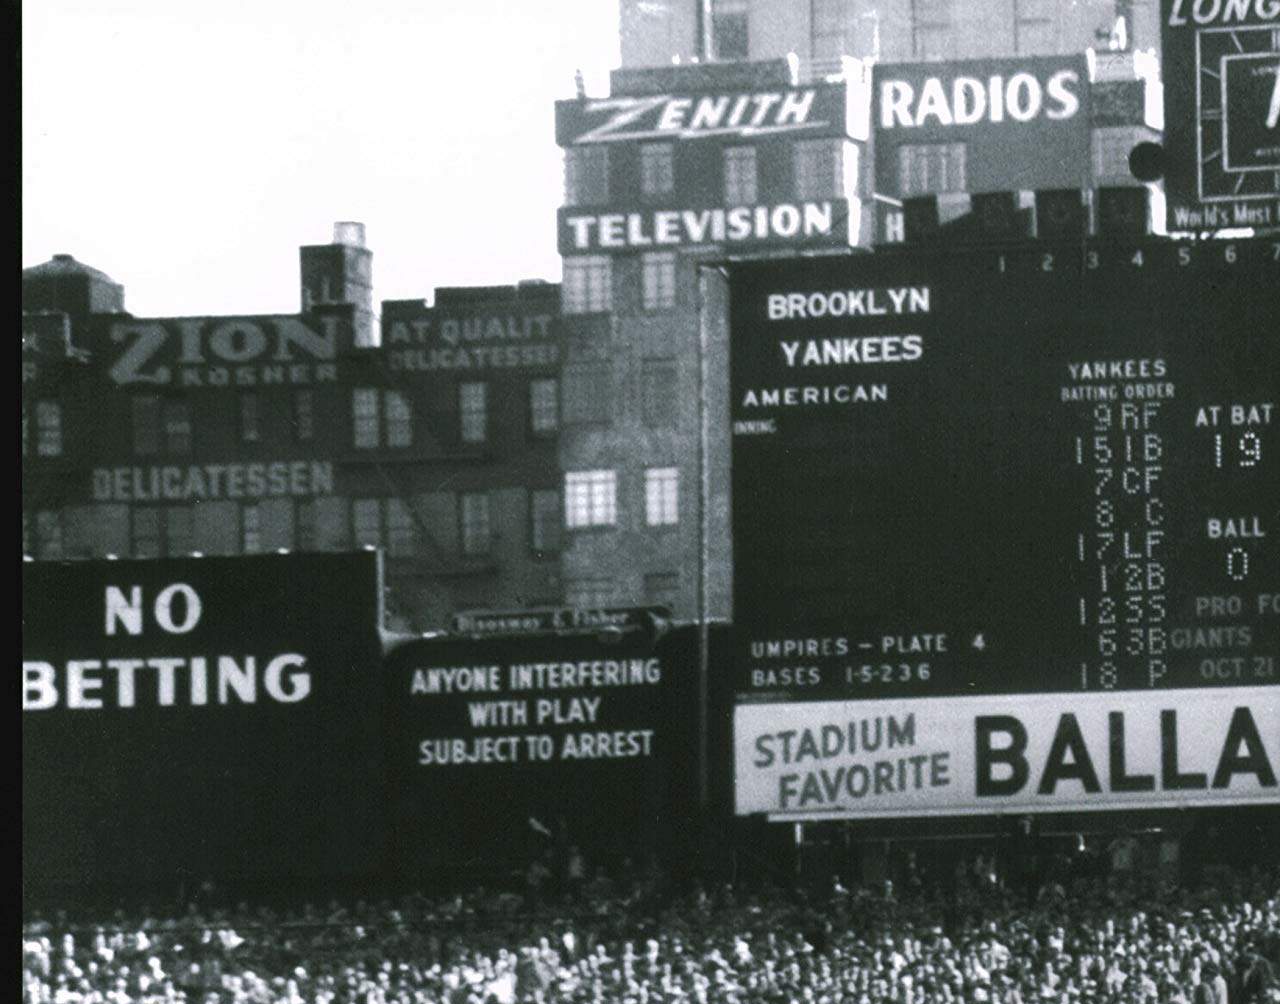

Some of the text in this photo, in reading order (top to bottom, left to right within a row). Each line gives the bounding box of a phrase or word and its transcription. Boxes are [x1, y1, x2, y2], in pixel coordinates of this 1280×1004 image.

[880, 71, 1080, 128] RADIOS
[574, 91, 830, 143] ZENITH
[567, 203, 832, 249] TELEVISION
[1175, 206, 1229, 227] World's
[1234, 204, 1271, 223] Most
[768, 287, 931, 321] BROOKLYN
[109, 316, 339, 385] ZION
[780, 335, 924, 369] YANKEES
[182, 363, 338, 386] KOSHER
[1069, 359, 1166, 379] YANKEES
[743, 384, 888, 407] AMERICAN
[1061, 382, 1175, 401] BATTING ORDER
[1195, 404, 1274, 427] AT BAT
[1215, 432, 1261, 467] 19
[93, 461, 333, 500] DELICATESSEN
[1208, 517, 1265, 539] BALL
[1227, 547, 1249, 581] 0
[105, 583, 202, 635] NO
[1196, 595, 1242, 616] PRO
[751, 634, 986, 658] UMPIRES PLATE 4
[1171, 626, 1251, 649] GIANTS
[22, 654, 311, 710] BETTING
[412, 659, 661, 694] ANYONE INTERFERING
[752, 667, 821, 686] BASES
[1200, 656, 1274, 679] OCT 21
[469, 697, 600, 727] WITH PLAY
[419, 731, 654, 765] SUBJECT TO ARREST
[754, 711, 917, 769] STADIUM
[778, 751, 951, 808] FAVORITE
